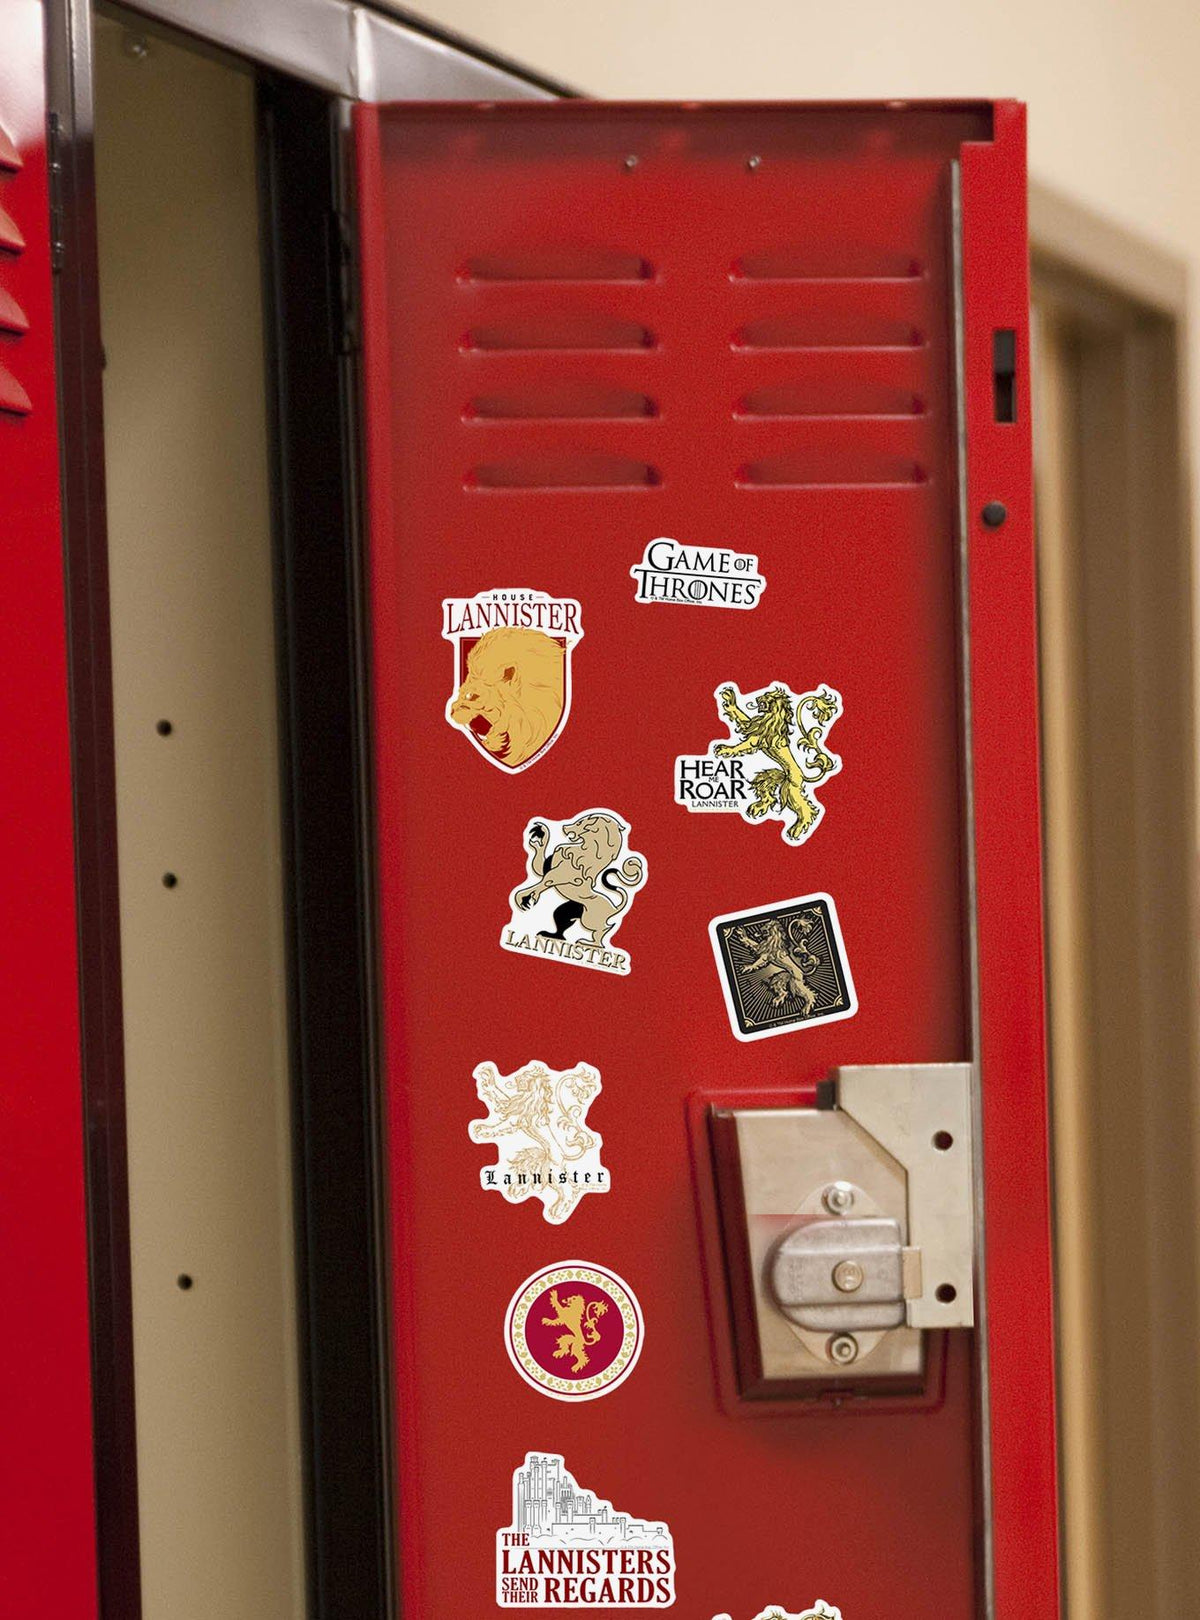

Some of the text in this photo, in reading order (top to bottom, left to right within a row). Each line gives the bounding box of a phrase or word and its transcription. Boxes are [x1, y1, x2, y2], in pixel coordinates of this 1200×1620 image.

[647, 542, 753, 573] GAME OF
[634, 569, 761, 604] THRONES
[492, 593, 534, 601] HOUSE
[447, 602, 579, 634] LANNISTER
[680, 760, 746, 779] HEAR
[680, 779, 747, 800] ROAR
[691, 800, 739, 808] LANNISTER
[505, 929, 627, 971] LANNISTER
[485, 1168, 604, 1186] Lannister
[502, 1533, 530, 1547] THE
[502, 1549, 671, 1575] LANNISTERS
[502, 1577, 539, 1591] SEND
[544, 1577, 671, 1603] REGARDS
[502, 1591, 539, 1603] THEIR
